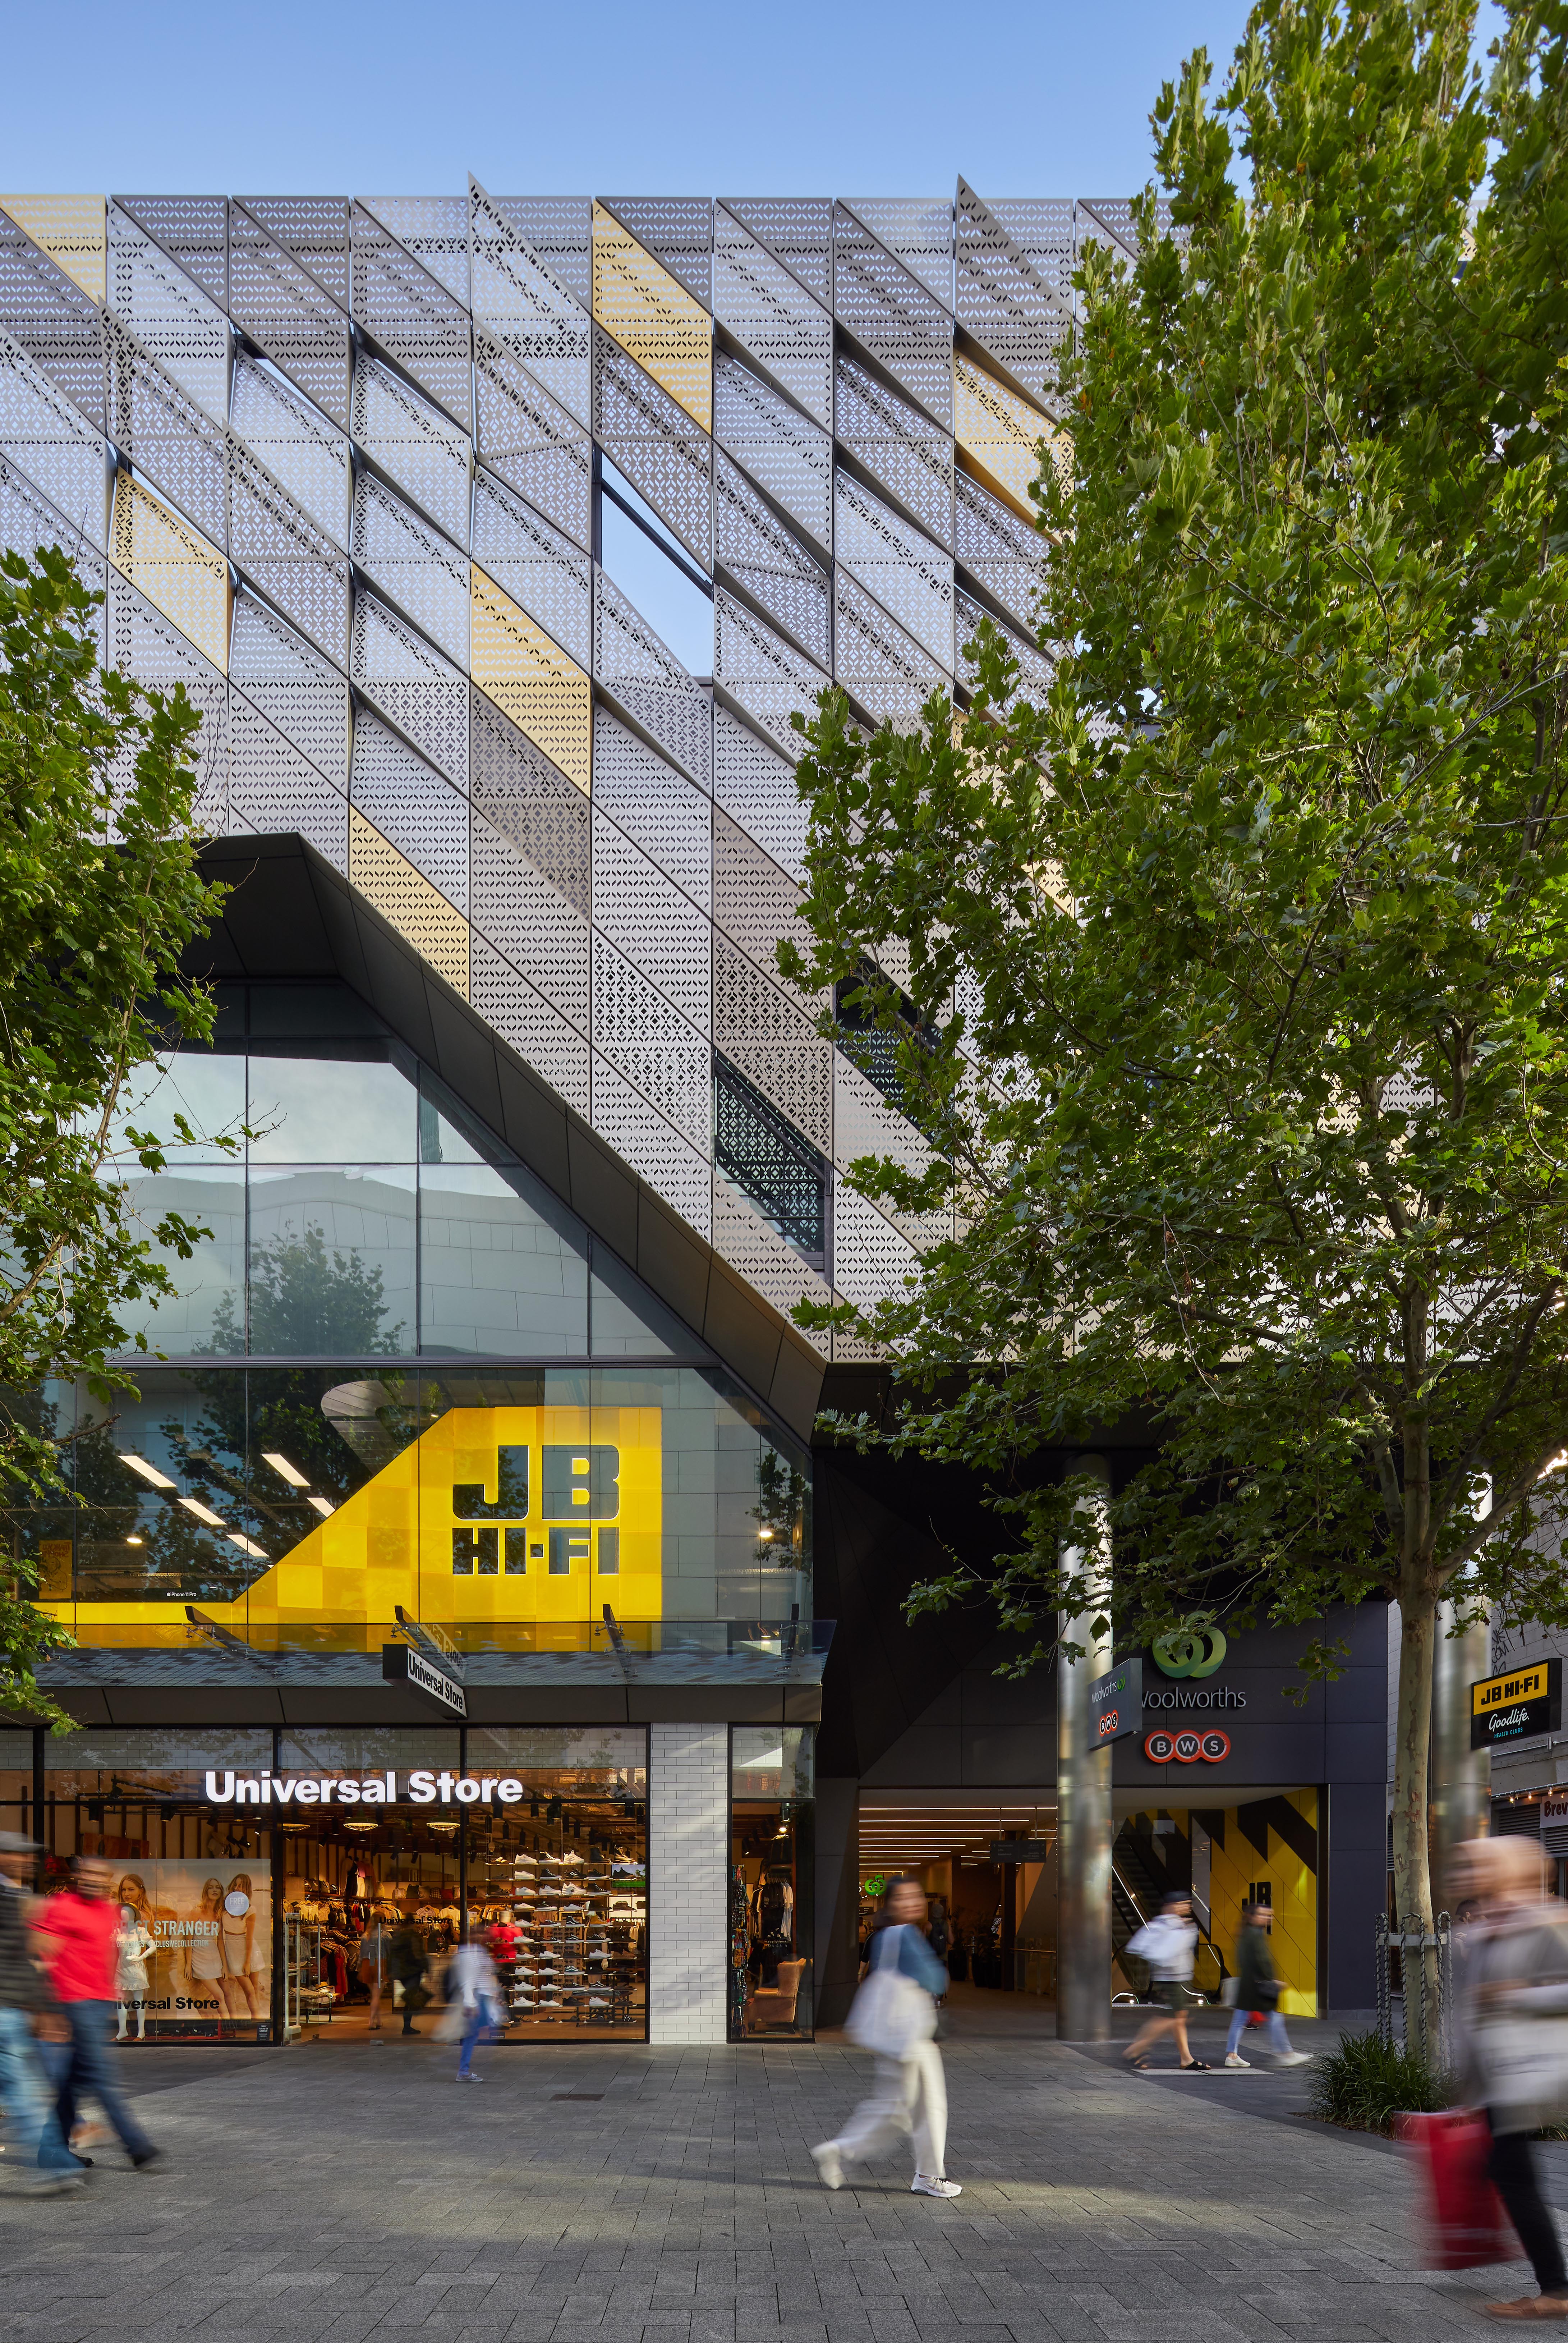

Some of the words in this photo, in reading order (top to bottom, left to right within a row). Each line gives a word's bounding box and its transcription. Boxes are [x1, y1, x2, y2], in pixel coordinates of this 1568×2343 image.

[452, 1445, 619, 1520] JB
[409, 1653, 443, 1697] Universal
[445, 1681, 463, 1710] Store
[1092, 1680, 1117, 1704] Woolworths
[1481, 1686, 1502, 1705] JB
[1102, 1717, 1116, 1730] BWS
[1157, 1741, 1219, 1752] BWS
[205, 1771, 396, 1803] Universal
[409, 1771, 523, 1803] Store
[154, 1920, 219, 1936] STRANGER
[175, 1997, 220, 2009] Store
